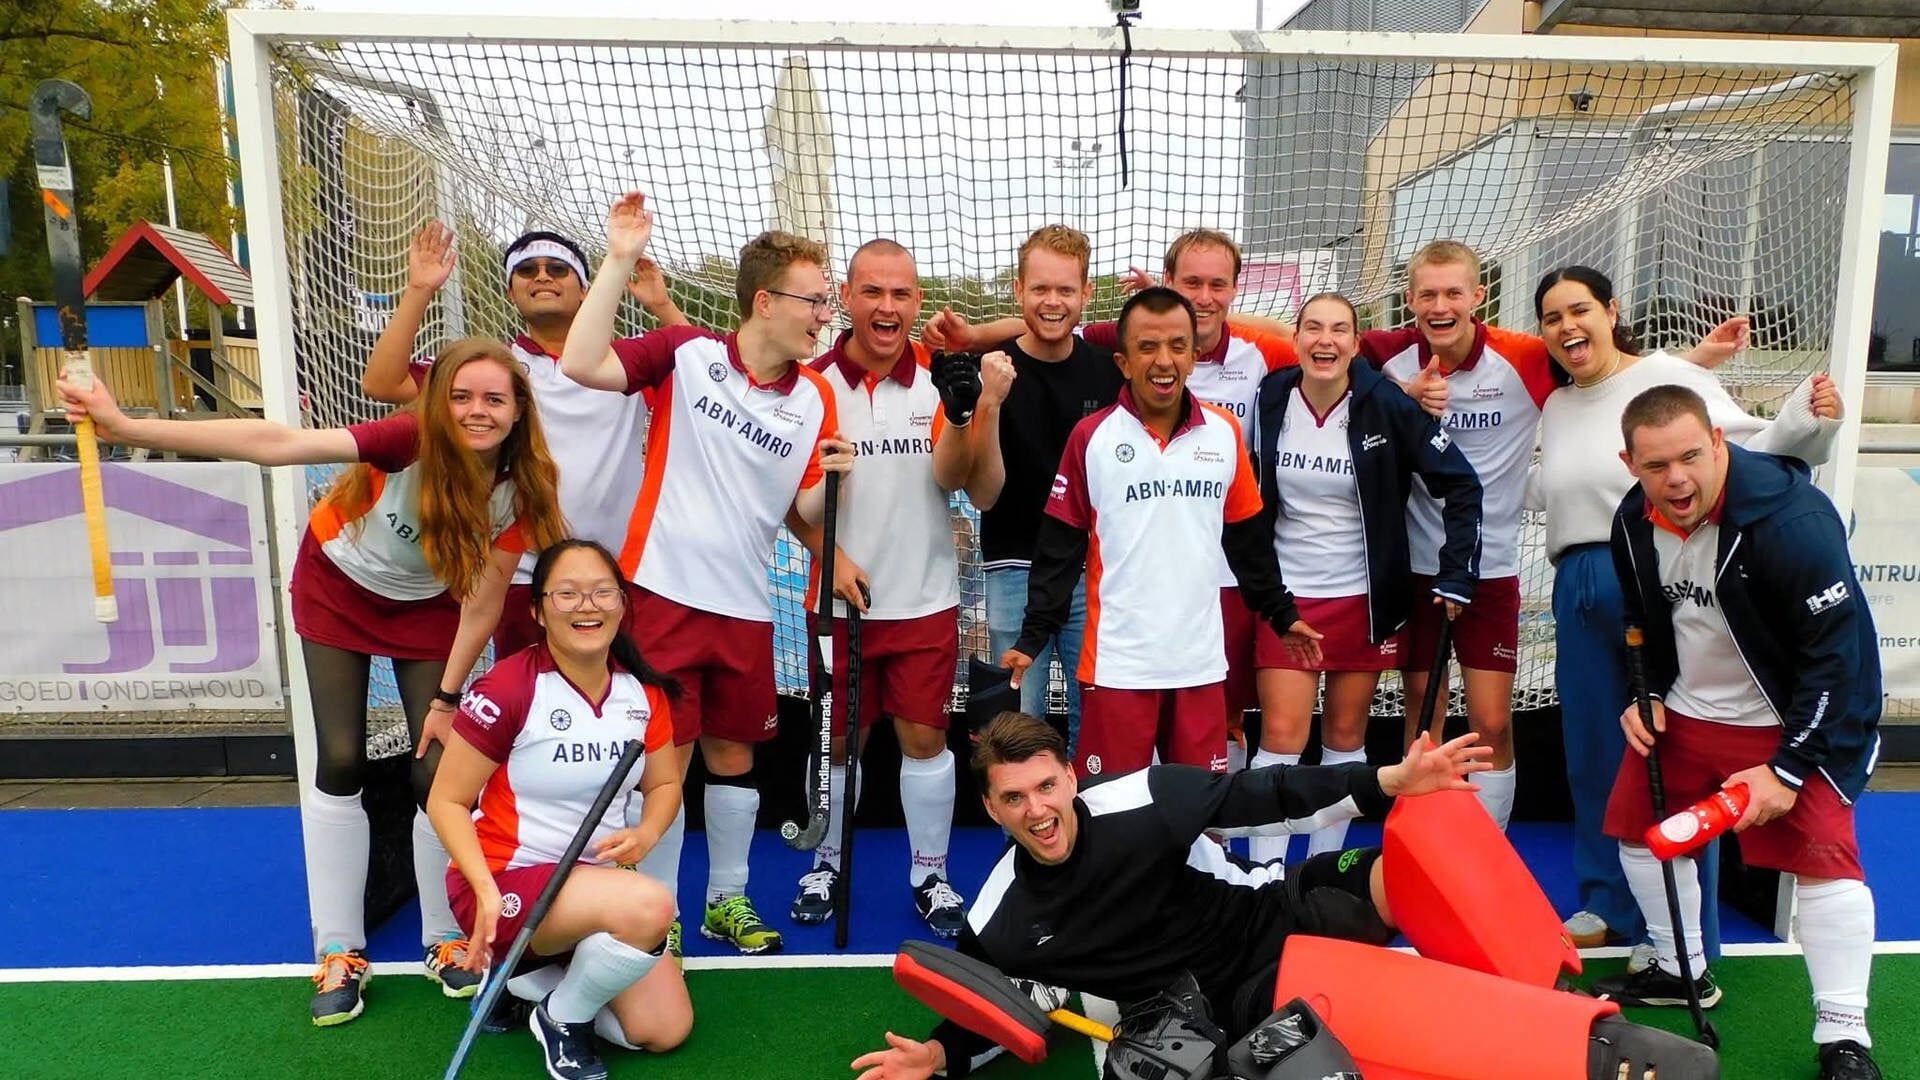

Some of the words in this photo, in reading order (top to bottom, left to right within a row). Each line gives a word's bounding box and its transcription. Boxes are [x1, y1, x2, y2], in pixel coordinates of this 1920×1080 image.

[93, 679, 265, 700] ONDERHOUD
[819, 692, 833, 753] maharadja
[818, 756, 830, 790] indian
